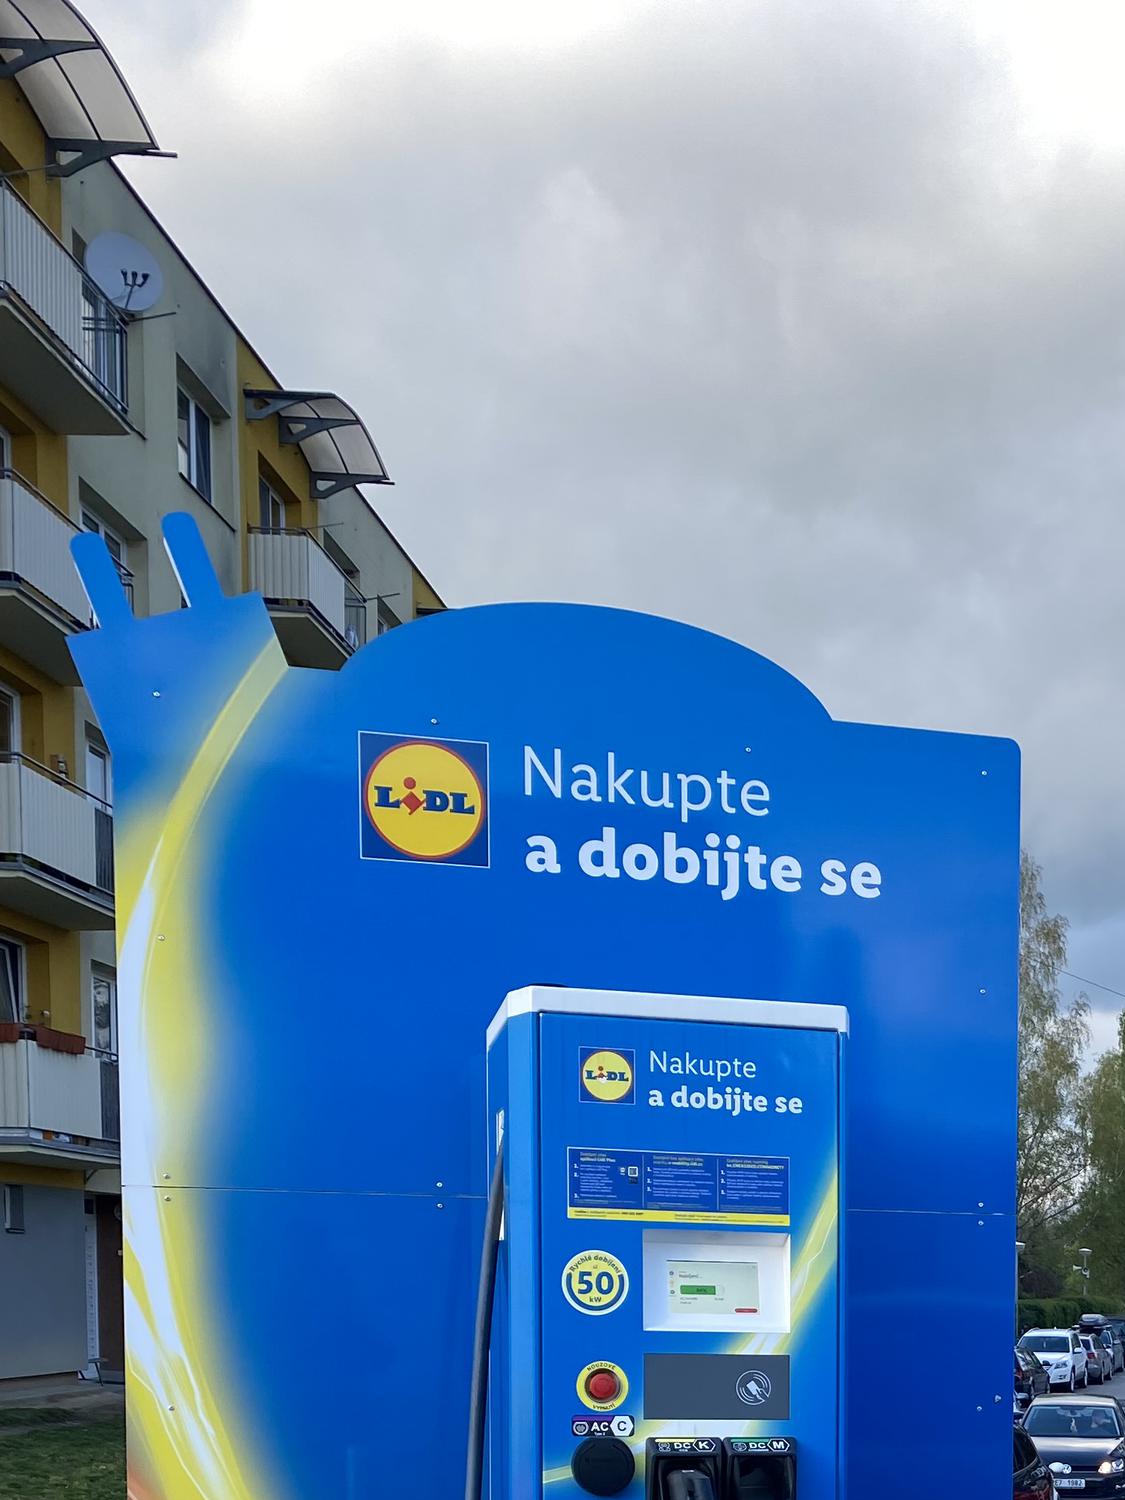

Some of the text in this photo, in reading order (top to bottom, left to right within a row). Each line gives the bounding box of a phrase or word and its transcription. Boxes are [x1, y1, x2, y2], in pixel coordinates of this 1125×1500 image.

[523, 745, 771, 823] Nakupte
[525, 827, 882, 900] a dobijte se
[650, 1050, 757, 1081] Nakupte
[648, 1085, 803, 1116] a dobijte se
[578, 1270, 614, 1295] 50
[590, 1420, 627, 1432] AC C
[699, 1441, 710, 1449] K
[773, 1440, 785, 1449] M
